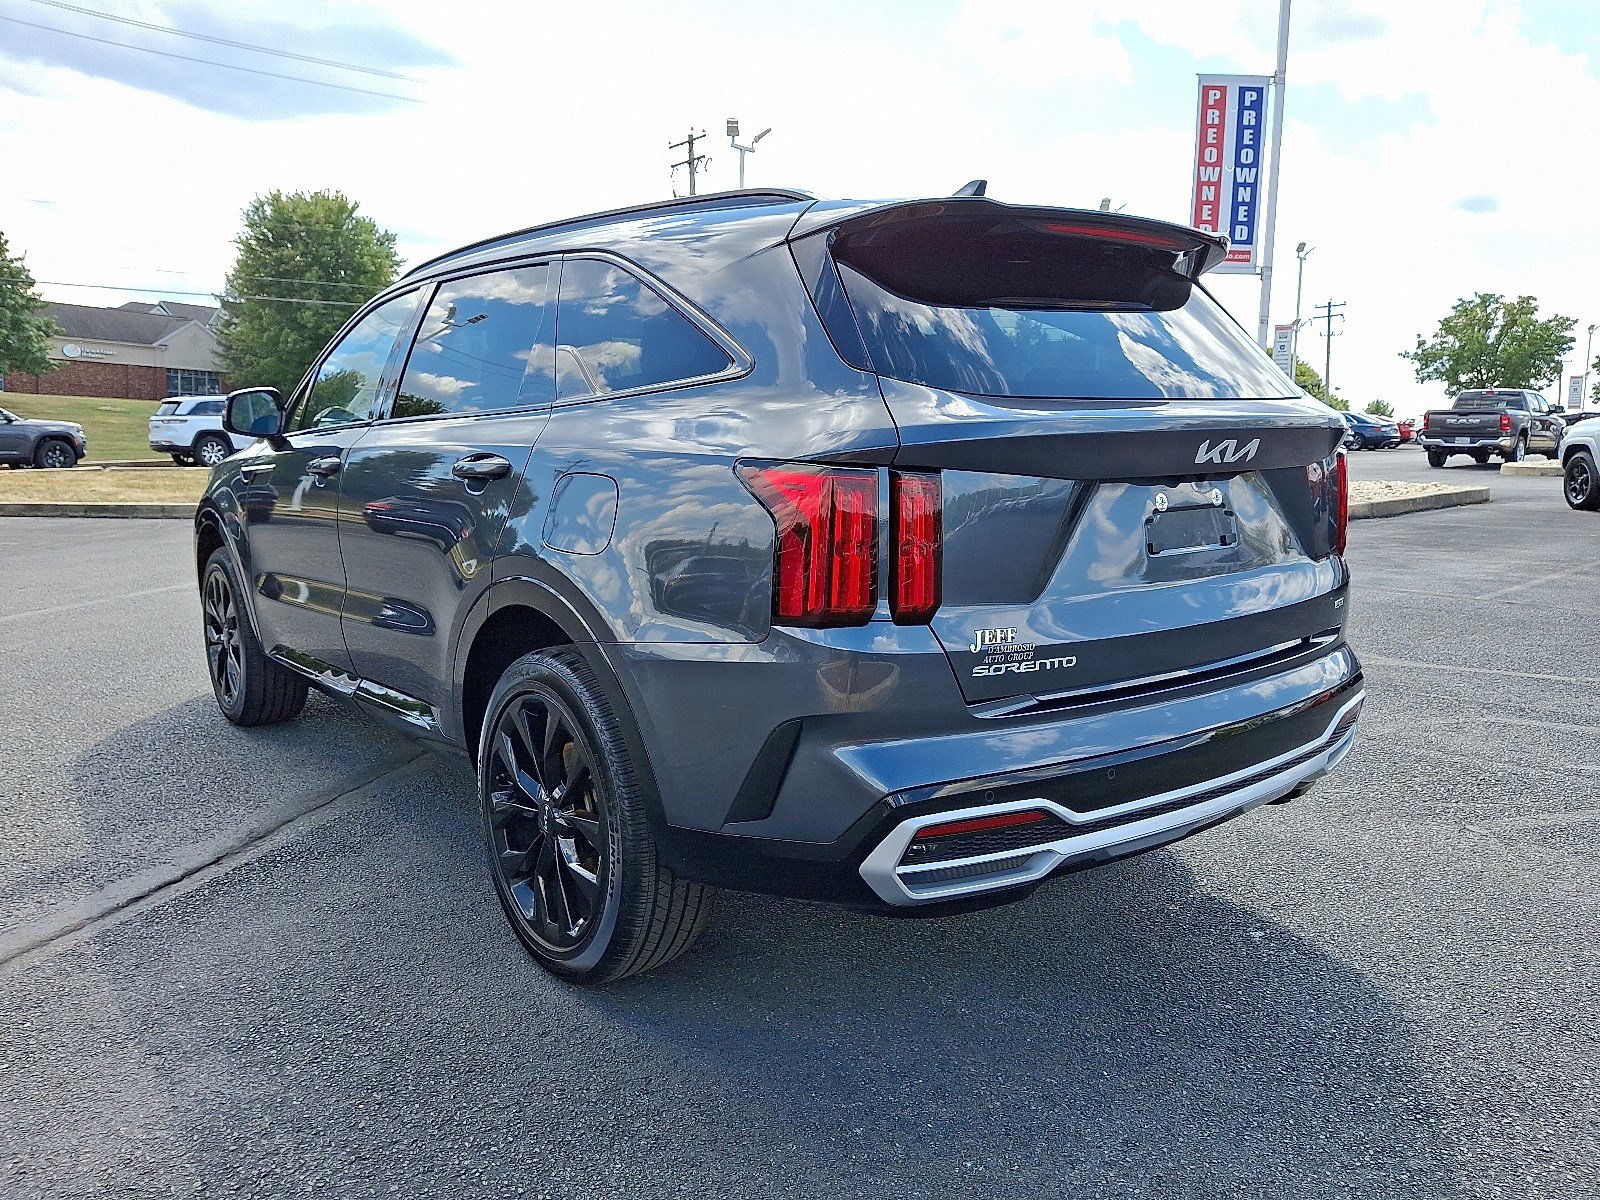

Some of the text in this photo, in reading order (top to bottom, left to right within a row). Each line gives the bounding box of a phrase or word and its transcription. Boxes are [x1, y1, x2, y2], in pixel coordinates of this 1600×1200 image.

[1234, 90, 1258, 241] PREOWNED
[1195, 438, 1260, 464] KIA
[969, 627, 1017, 653] JEFF
[987, 643, 1036, 654] D'AMBROSIO
[971, 656, 1077, 676] SORENTO
[982, 651, 1034, 664] AUTO GROUP
